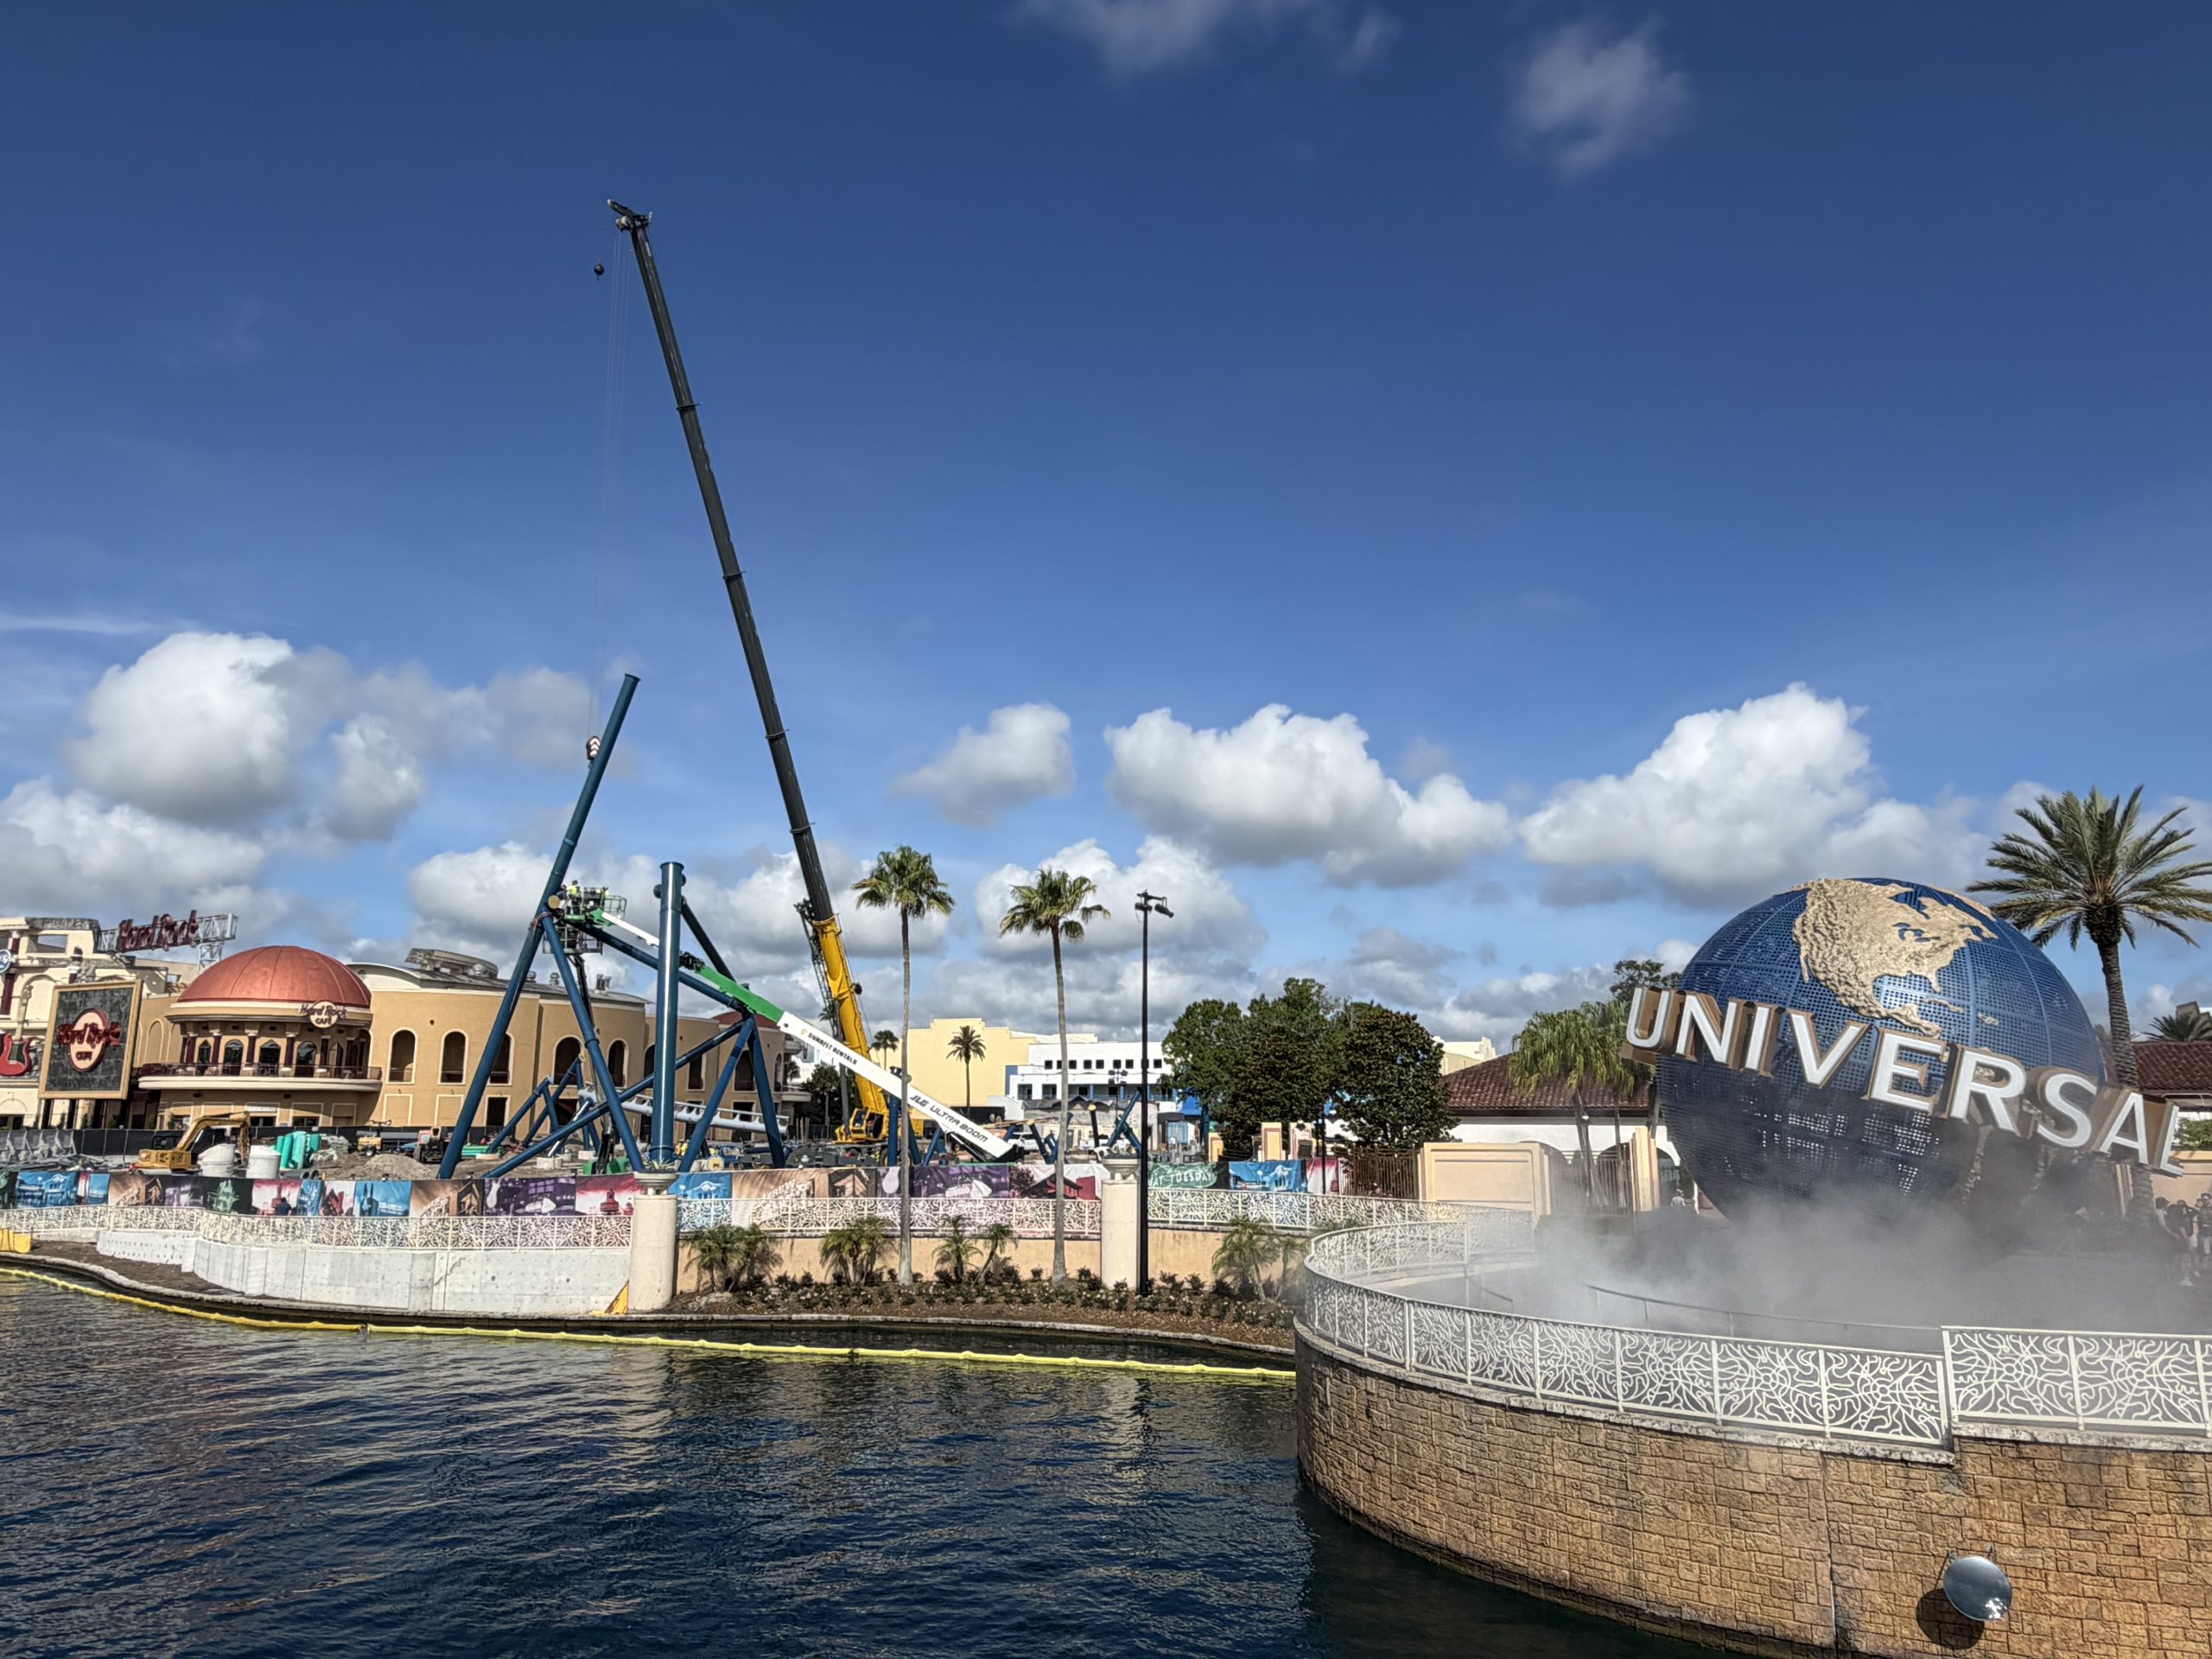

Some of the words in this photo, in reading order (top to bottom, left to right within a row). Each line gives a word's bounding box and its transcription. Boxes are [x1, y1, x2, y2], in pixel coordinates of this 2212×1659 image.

[1626, 988, 2183, 1177] UNIVERSAL
[910, 1096, 930, 1107] JLG
[930, 1105, 960, 1126] ULTRA
[959, 1123, 988, 1142] BOOM
[1169, 1171, 1211, 1185] TUESDAY
